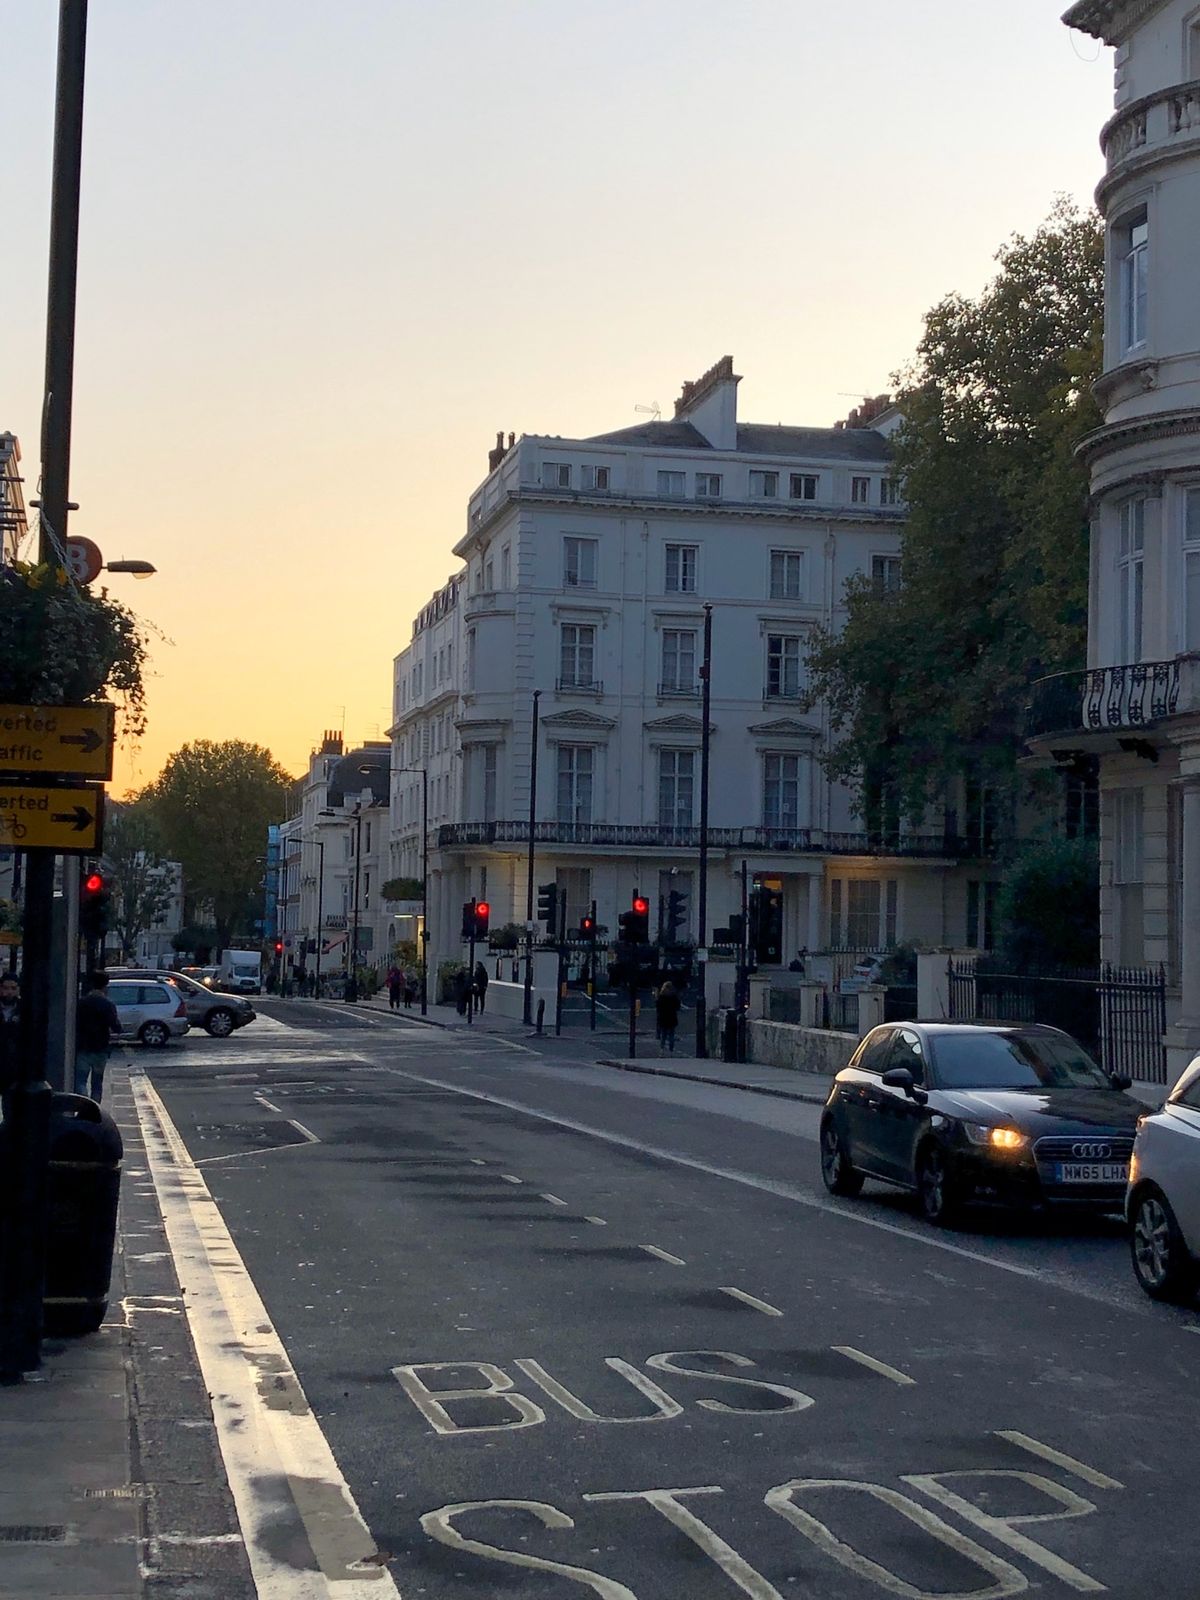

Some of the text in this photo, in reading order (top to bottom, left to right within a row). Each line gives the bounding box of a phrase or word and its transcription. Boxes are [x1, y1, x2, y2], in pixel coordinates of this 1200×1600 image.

[0, 715, 56, 732] erted
[391, 1349, 816, 1435] BUS
[418, 1469, 1109, 1600] STOP
